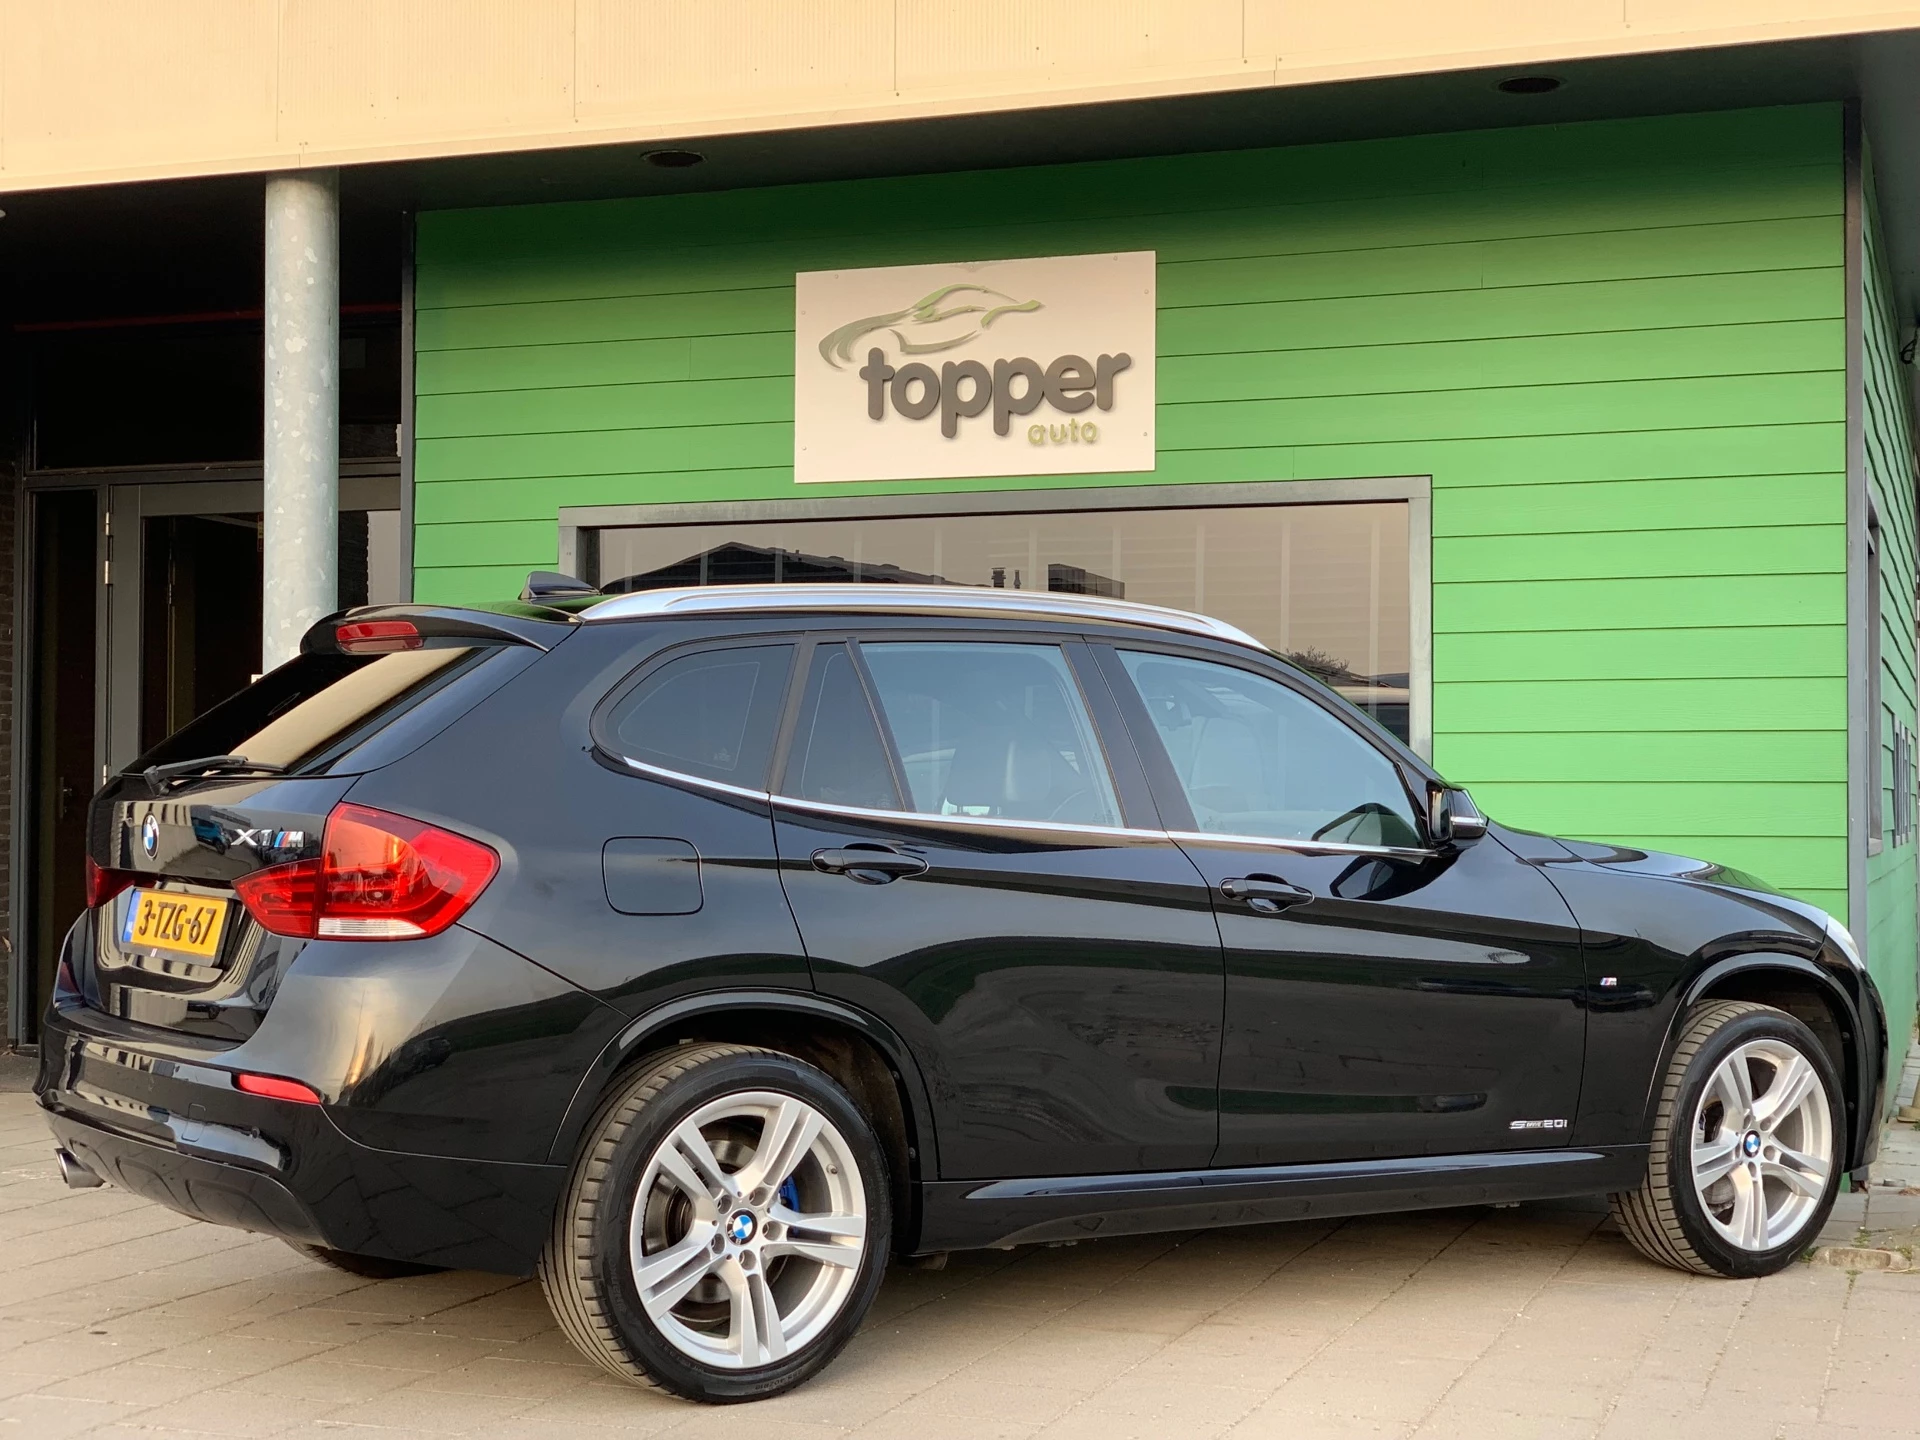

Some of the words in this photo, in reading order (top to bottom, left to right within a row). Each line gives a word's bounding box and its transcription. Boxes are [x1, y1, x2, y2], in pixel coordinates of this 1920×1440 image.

[859, 347, 1131, 438] topper
[1027, 417, 1098, 445] auto
[230, 828, 273, 846] X1
[138, 899, 217, 946] 3-TZG-67
